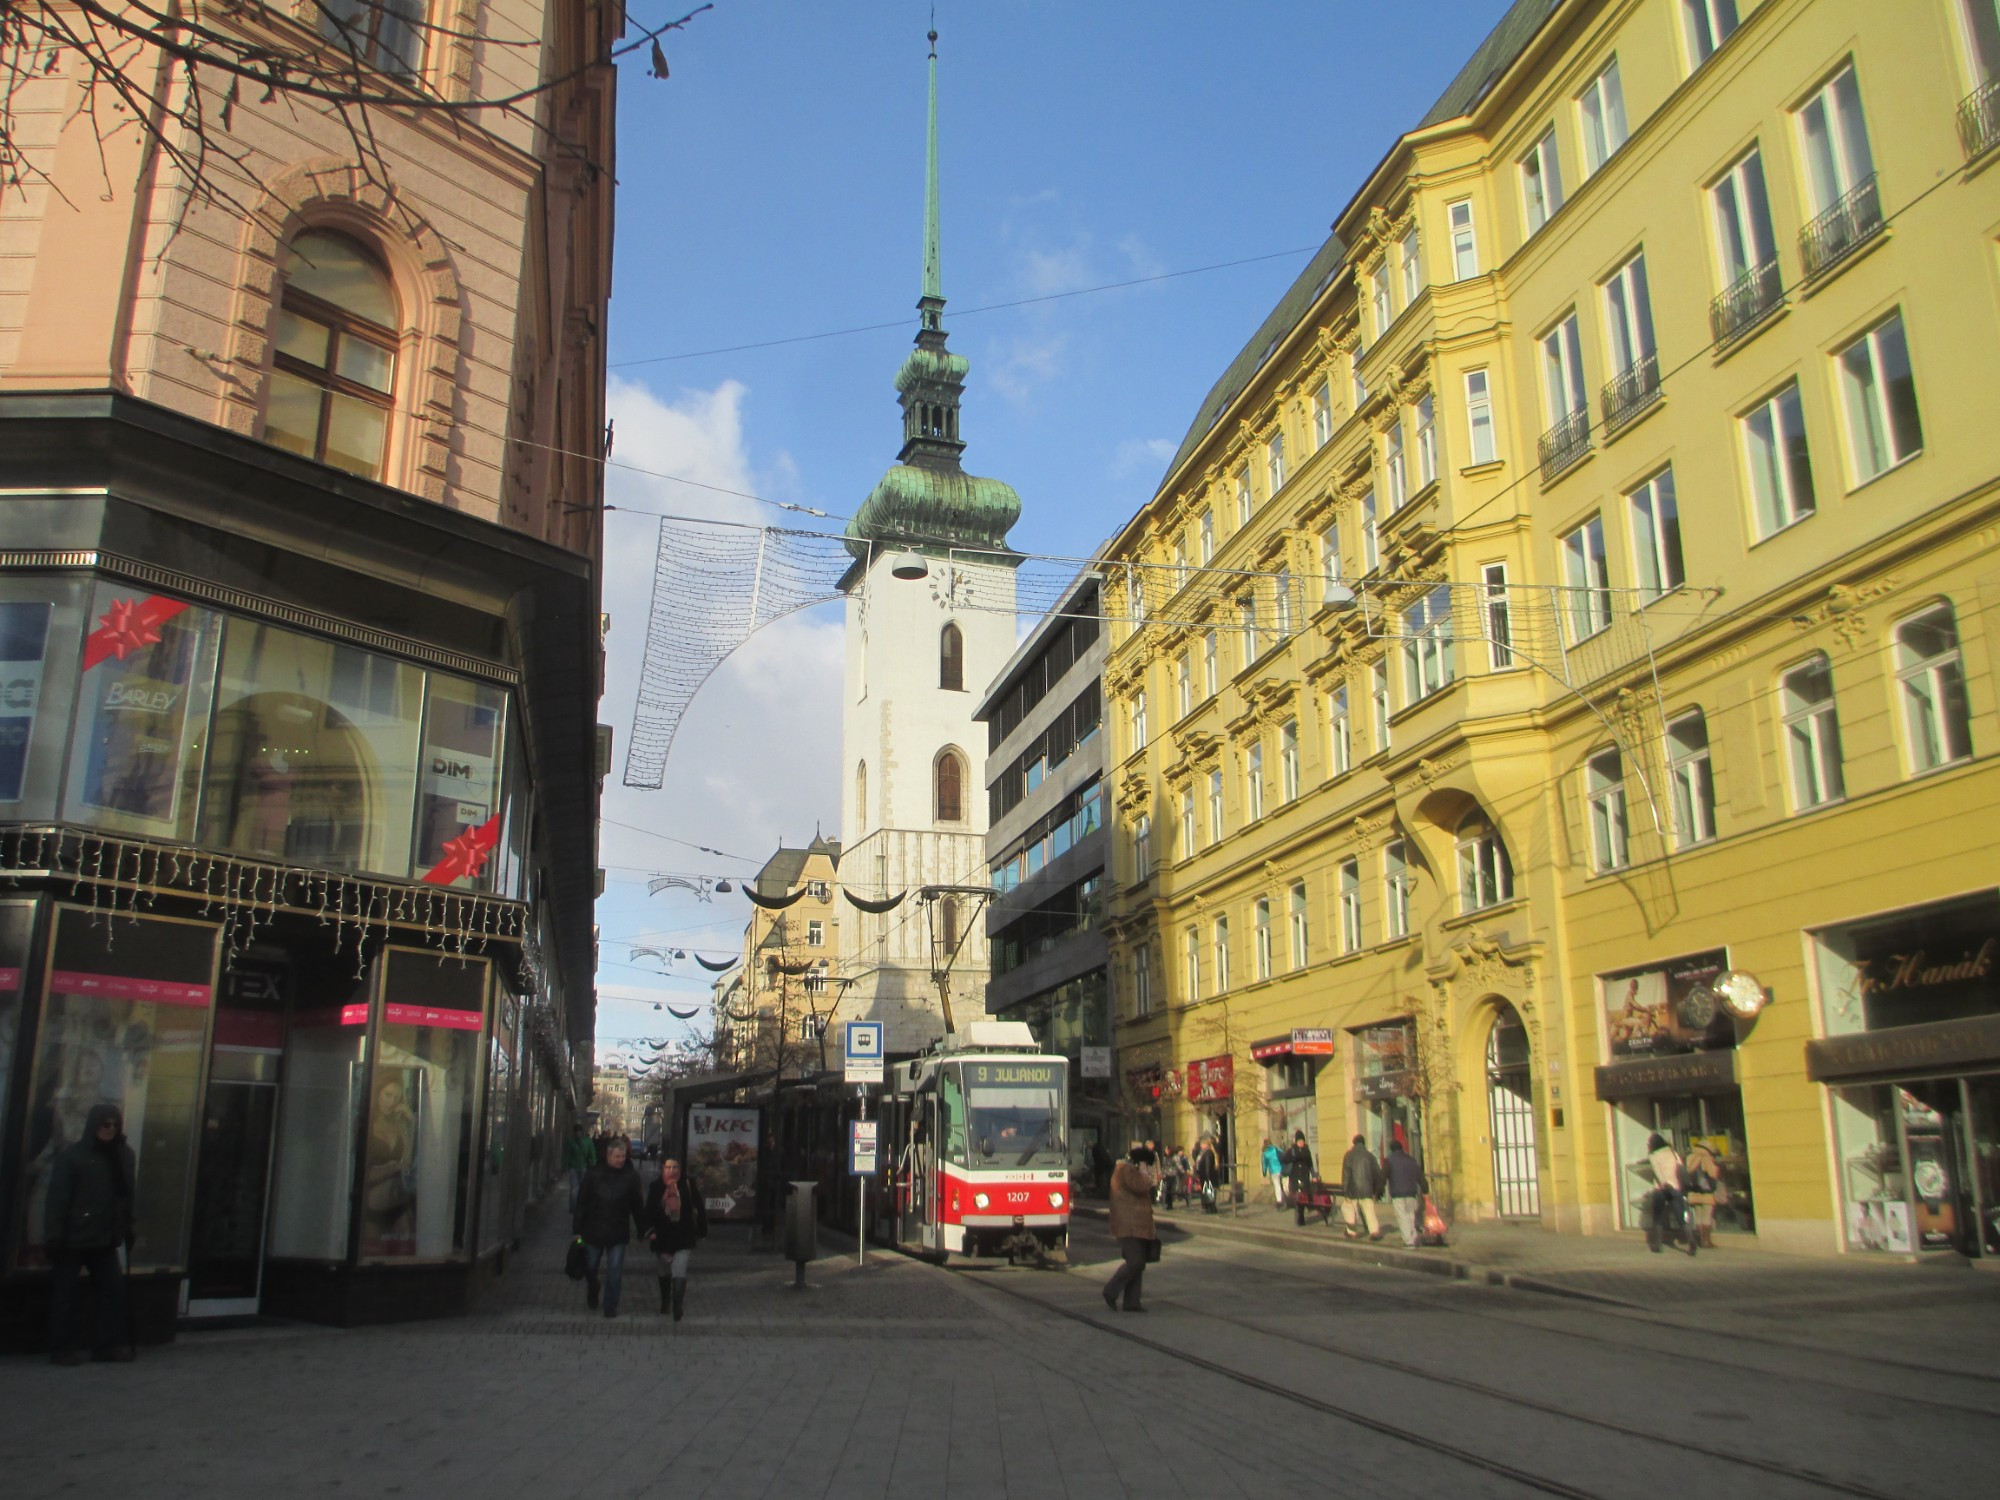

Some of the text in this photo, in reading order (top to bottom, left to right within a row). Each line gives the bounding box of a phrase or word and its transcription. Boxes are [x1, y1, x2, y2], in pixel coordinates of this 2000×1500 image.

[105, 681, 177, 710] BARLEY
[432, 757, 471, 780] DIM
[460, 807, 478, 817] DIM
[978, 1066, 988, 1082] 9
[713, 1119, 754, 1132] KFC
[1007, 1192, 1030, 1203] 1207
